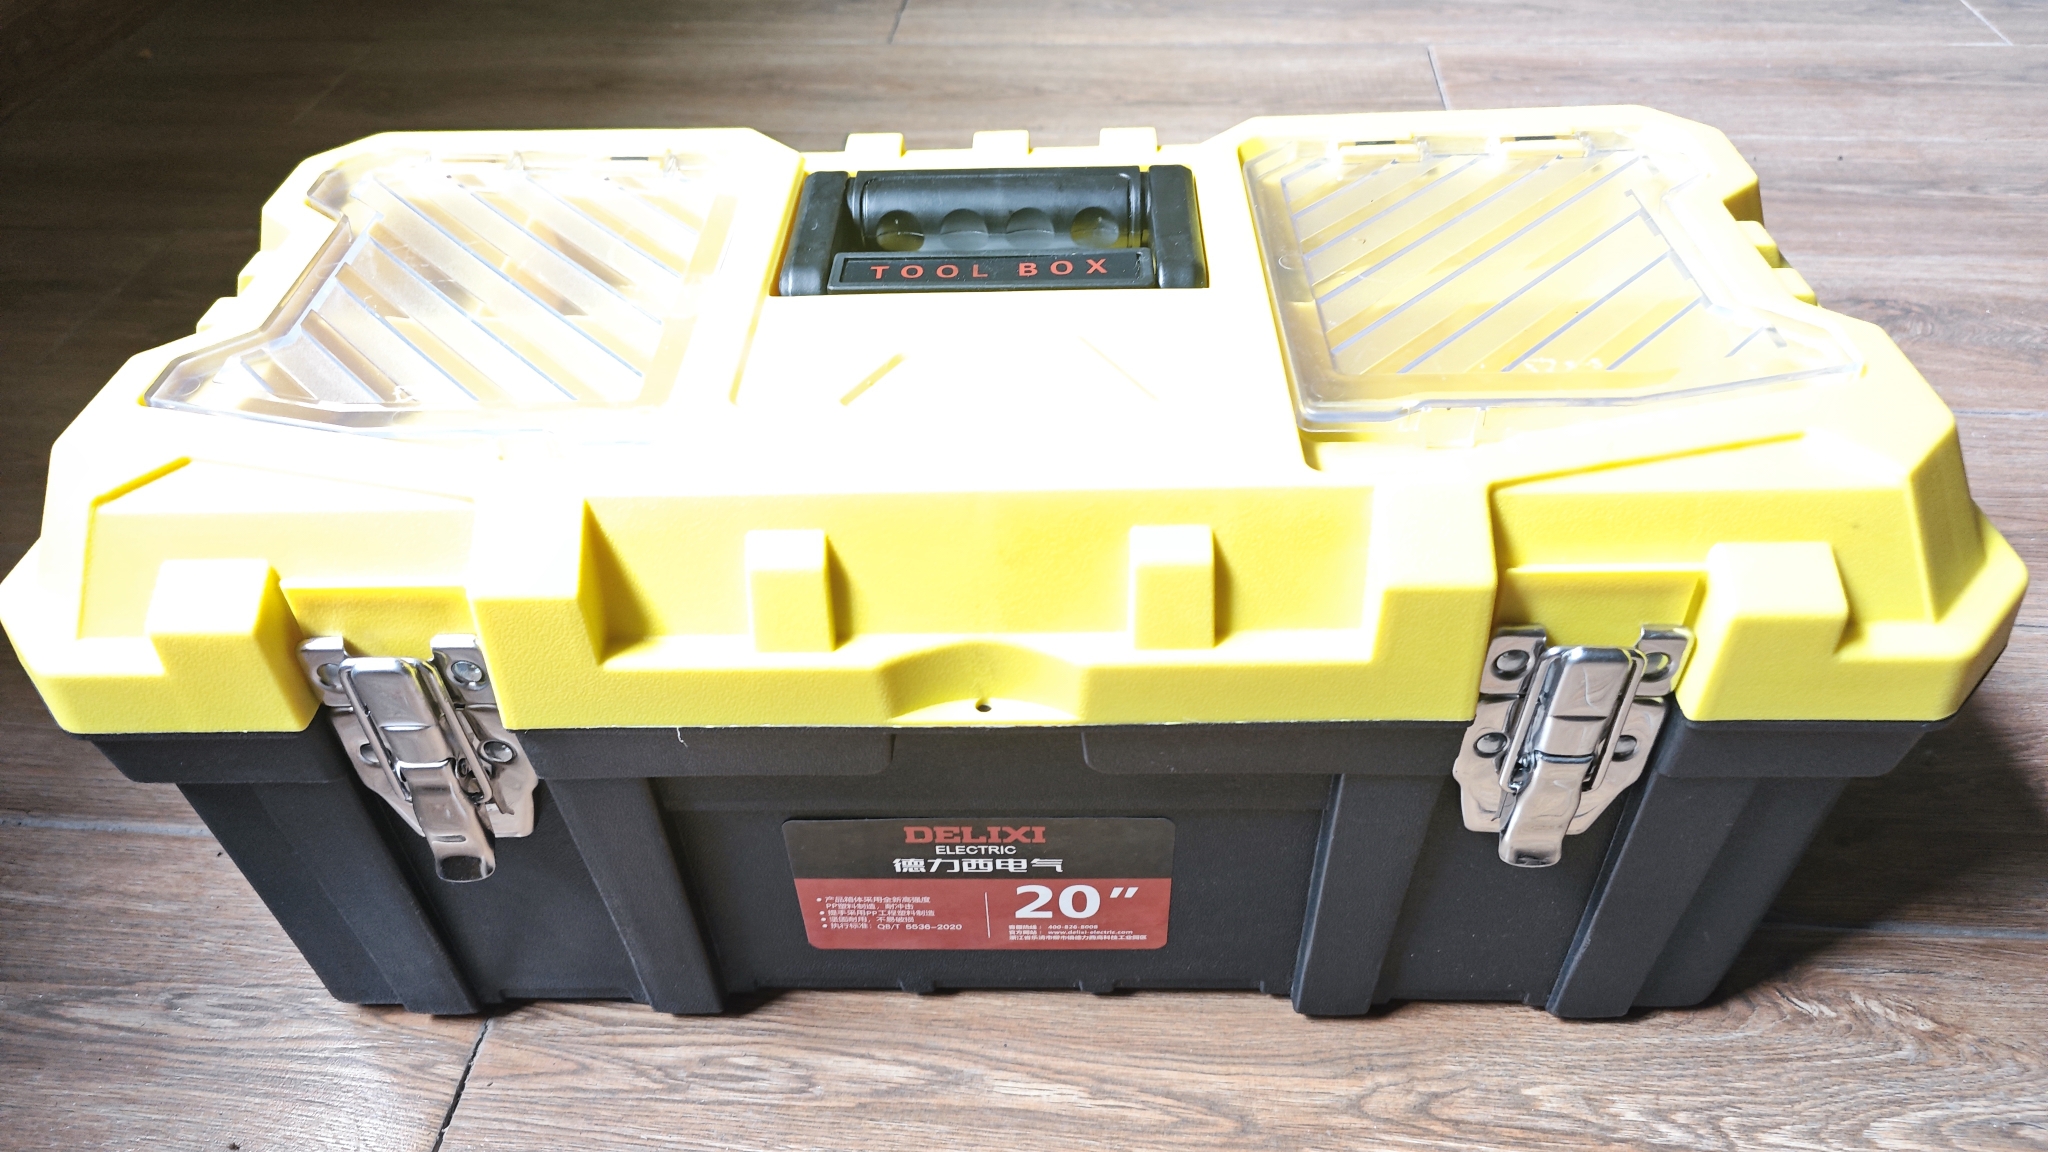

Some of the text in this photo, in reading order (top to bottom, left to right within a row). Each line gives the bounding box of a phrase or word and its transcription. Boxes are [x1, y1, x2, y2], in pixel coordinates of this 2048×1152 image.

[870, 258, 1108, 280] TOOL BOX
[903, 826, 1046, 844] DELIXI
[935, 845, 1017, 855] ELECTRIC
[892, 858, 1063, 873] 德力西电气
[825, 896, 931, 904] 产品箱体采用全新高强度
[877, 923, 901, 931] QB/T
